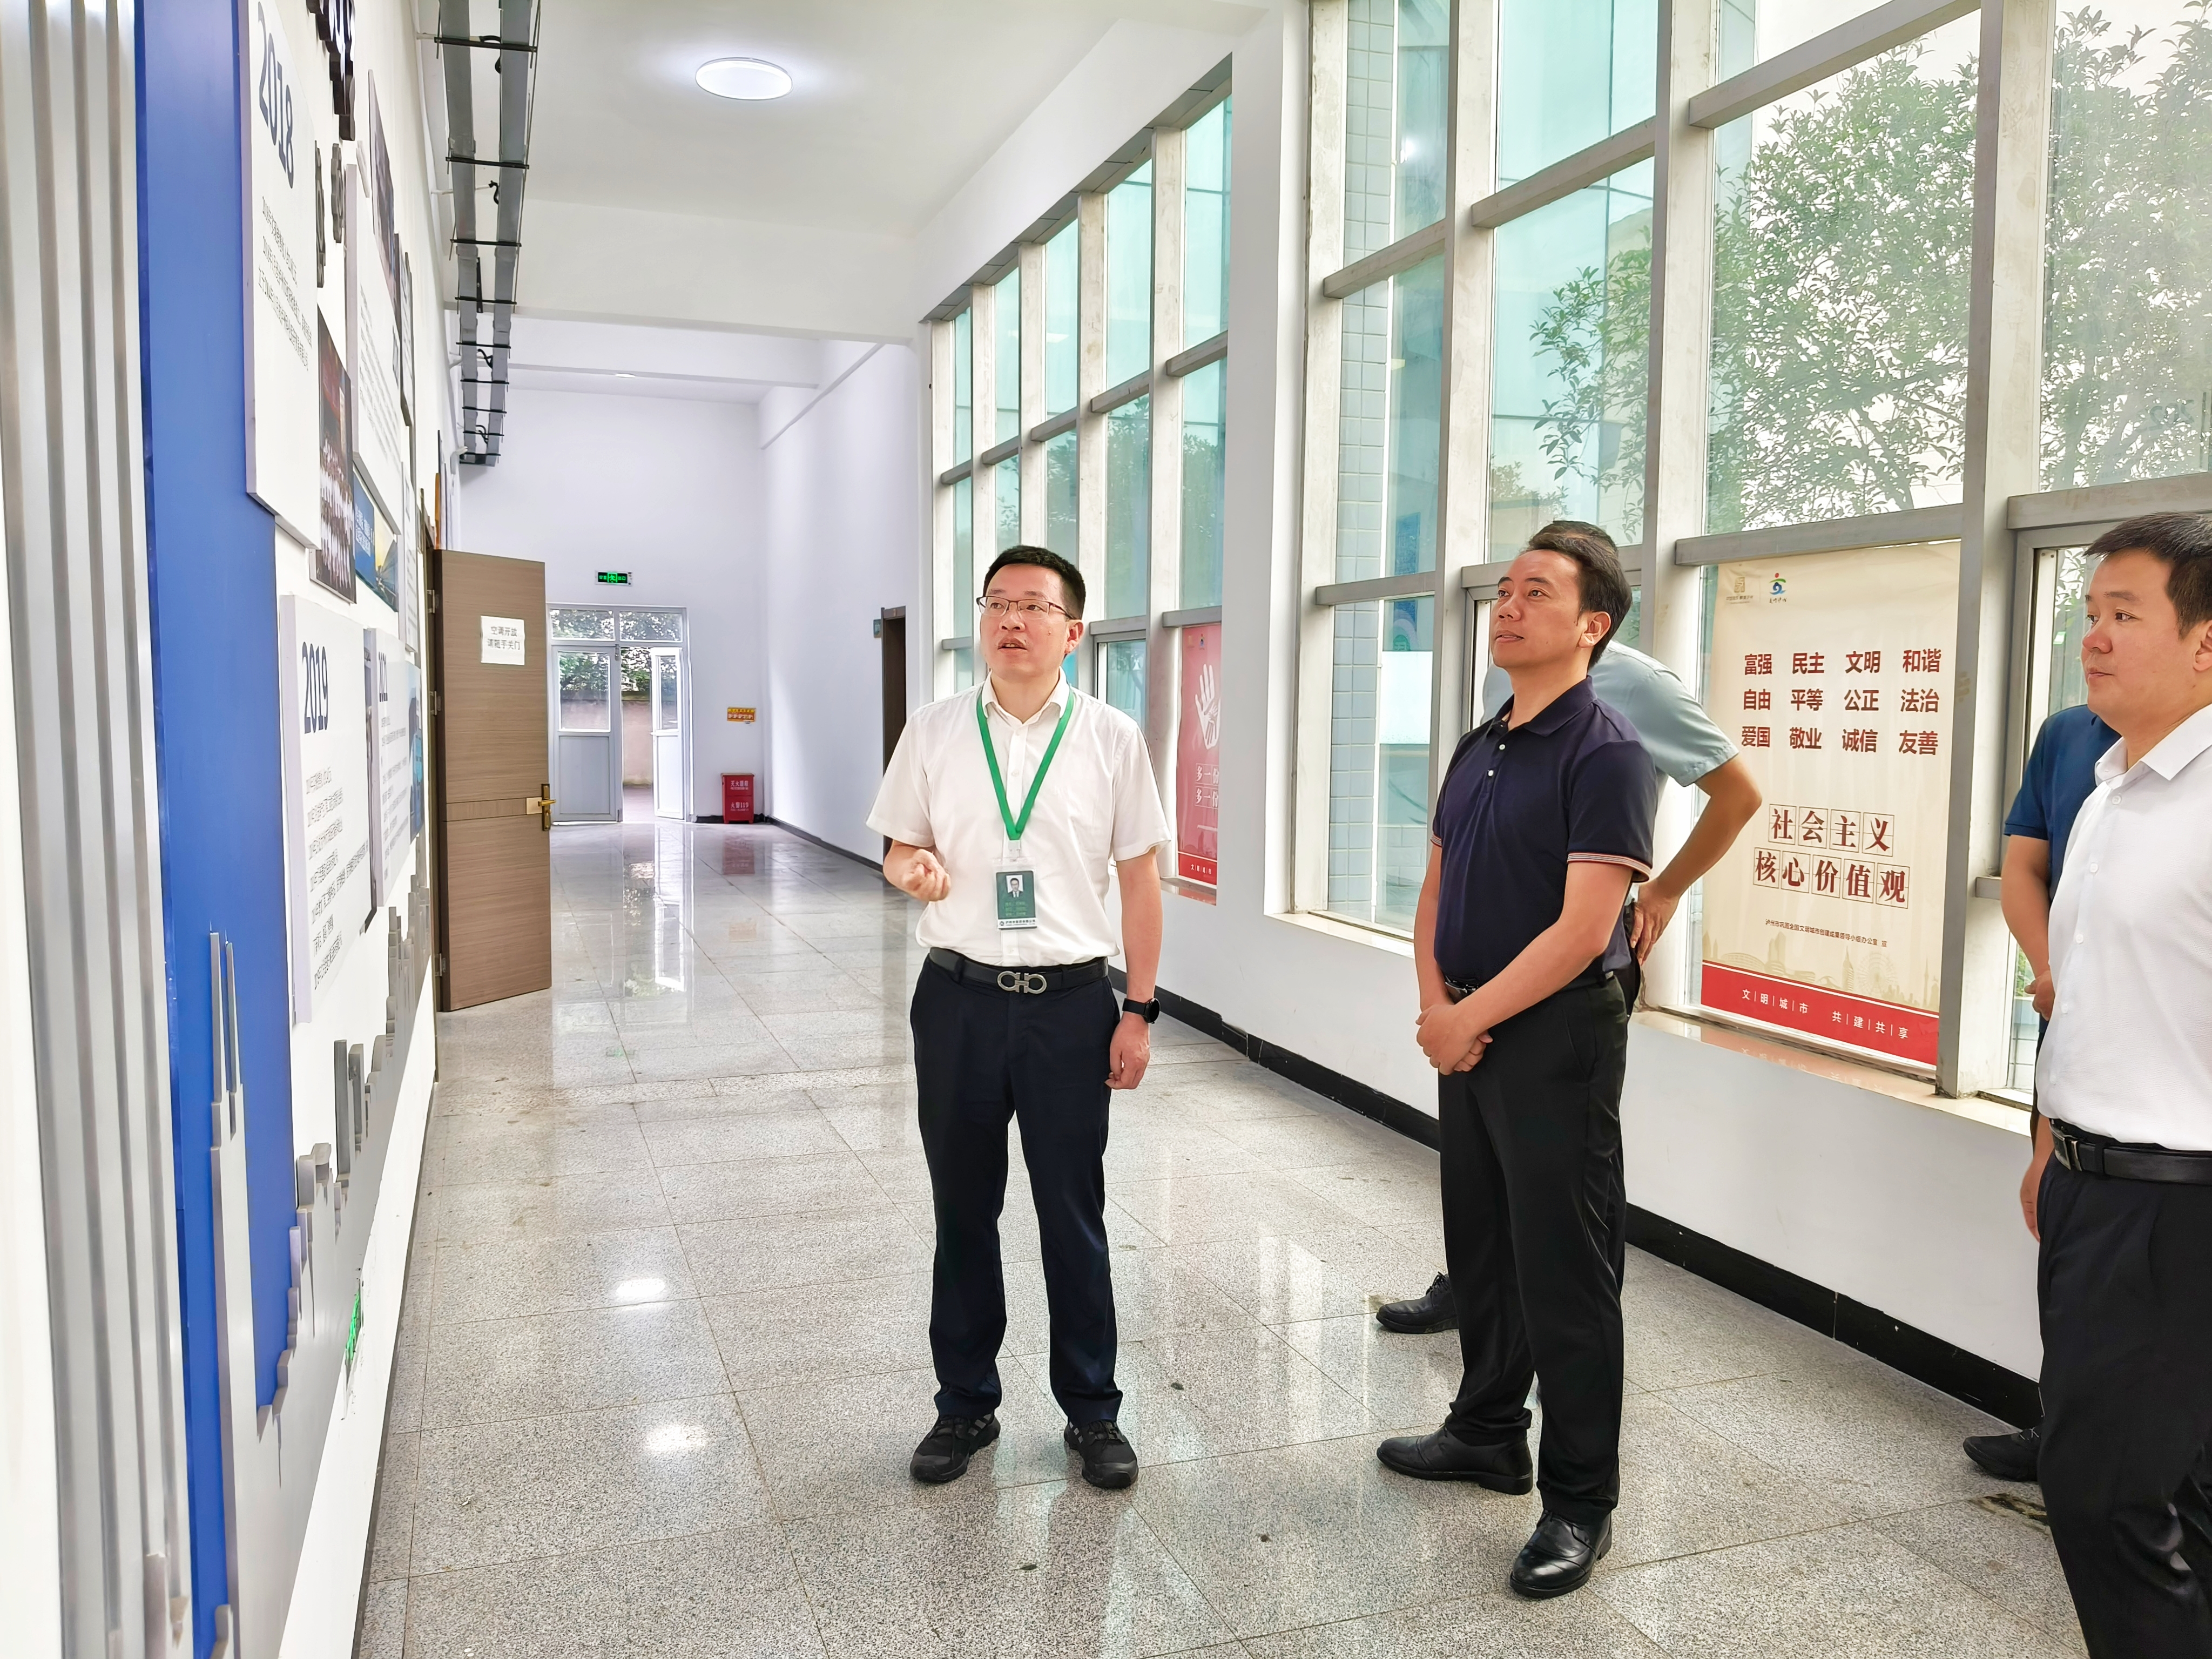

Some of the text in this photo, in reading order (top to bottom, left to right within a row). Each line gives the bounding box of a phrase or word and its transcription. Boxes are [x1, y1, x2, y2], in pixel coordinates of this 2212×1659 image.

[258, 1, 294, 189] 2018
[1745, 649, 1941, 676] 富强 民主 文明 和谐
[302, 641, 328, 734] 2019
[1743, 688, 1940, 713] 自由 平等 公正 法治
[1742, 726, 1939, 756] 爱国 敬业 诚信 友善
[1771, 808, 1891, 852] 社会主义
[1755, 851, 1907, 903] 核心价值观
